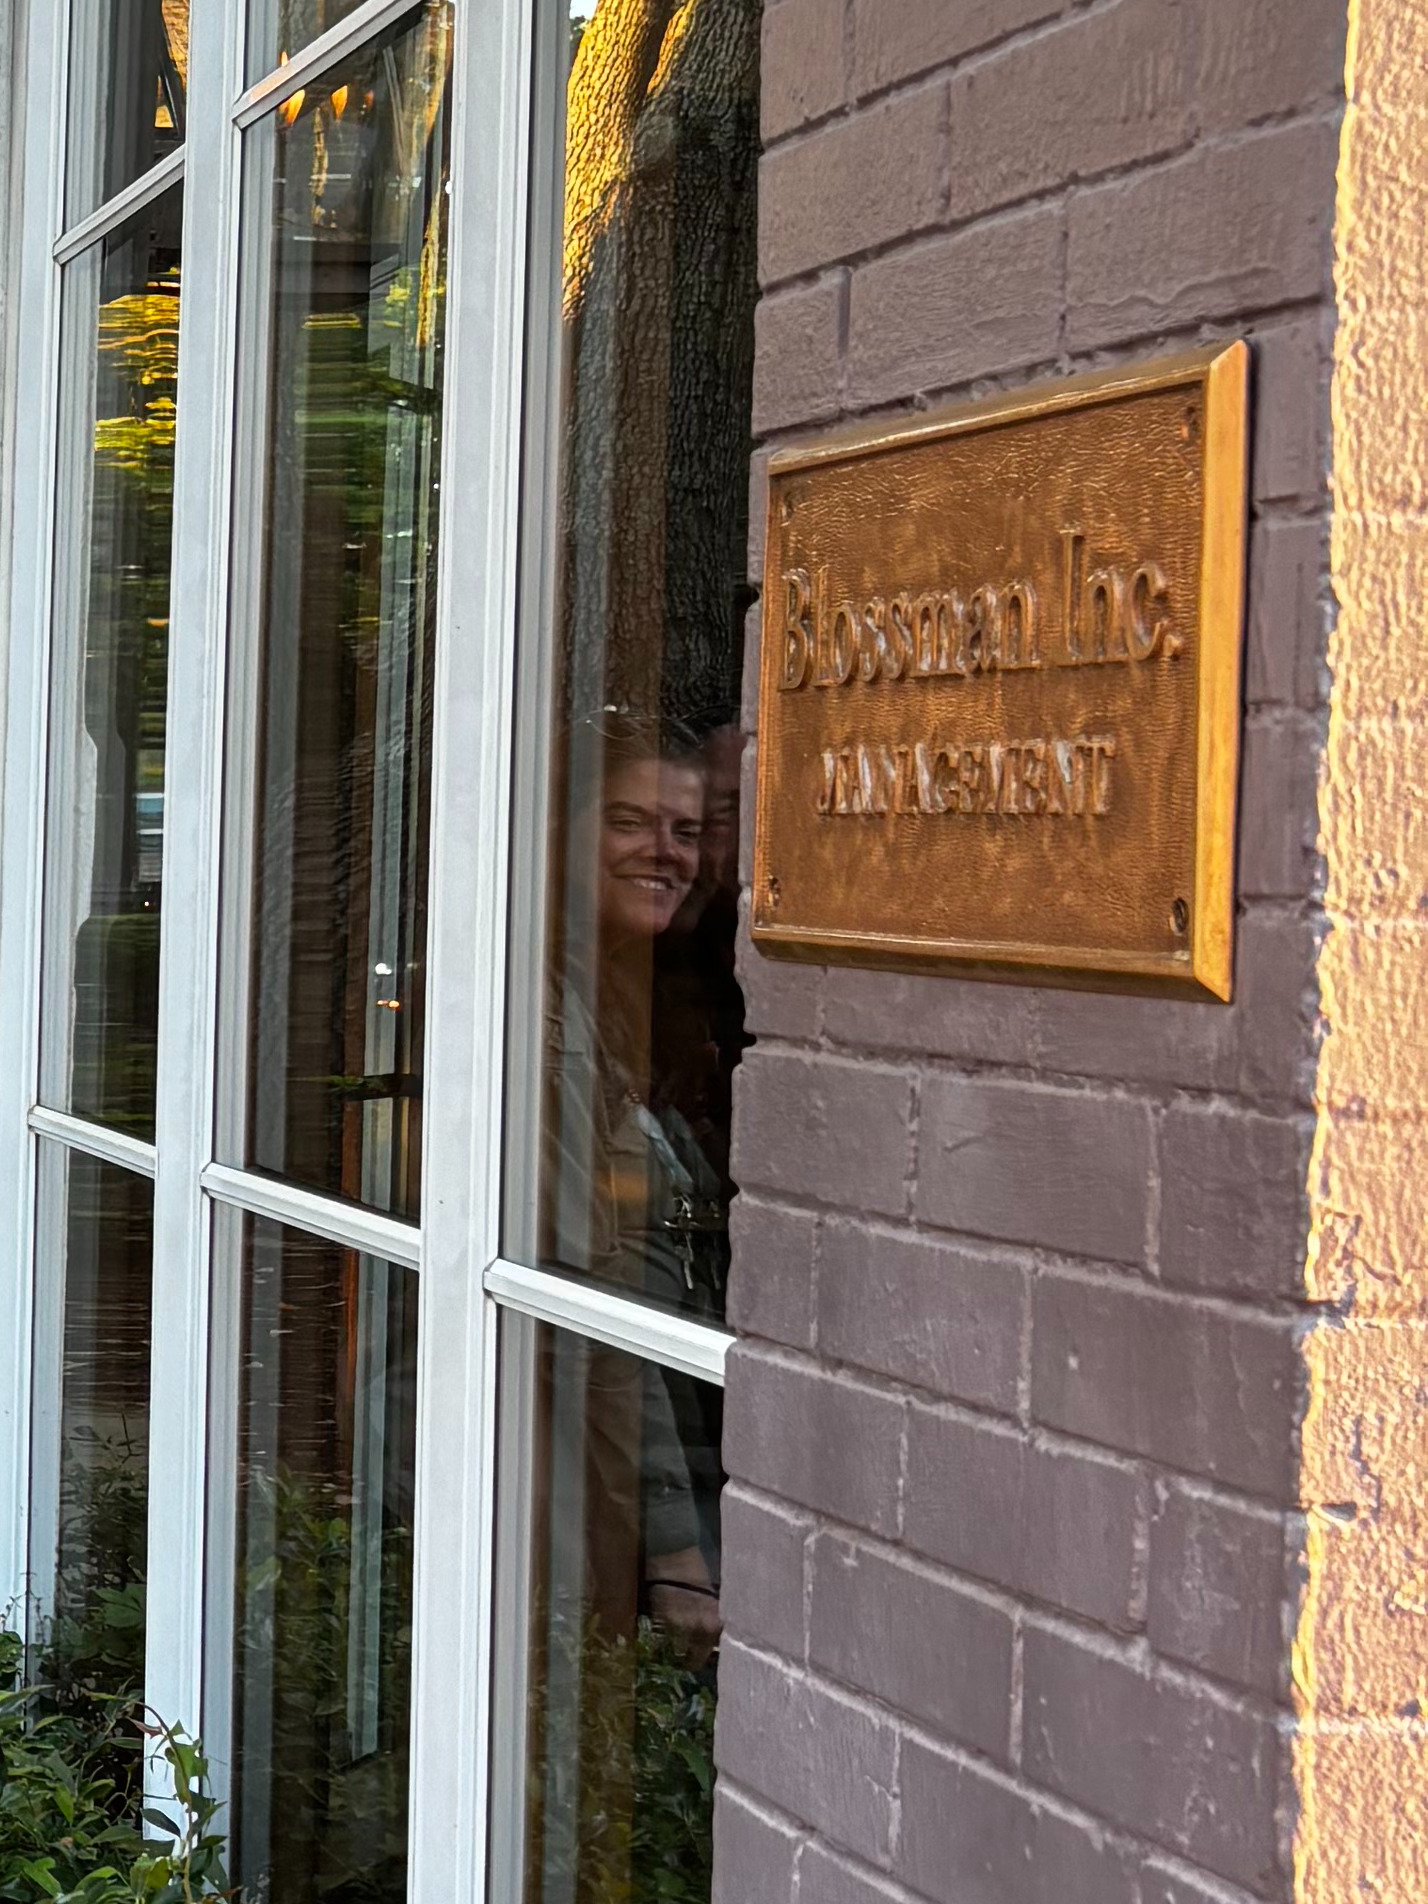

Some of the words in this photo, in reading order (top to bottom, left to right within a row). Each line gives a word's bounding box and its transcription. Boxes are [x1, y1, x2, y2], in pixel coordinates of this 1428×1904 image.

[778, 568, 1041, 690] Blossman
[1058, 528, 1183, 667] Inc.
[817, 734, 1116, 815] MANAGEMENT
